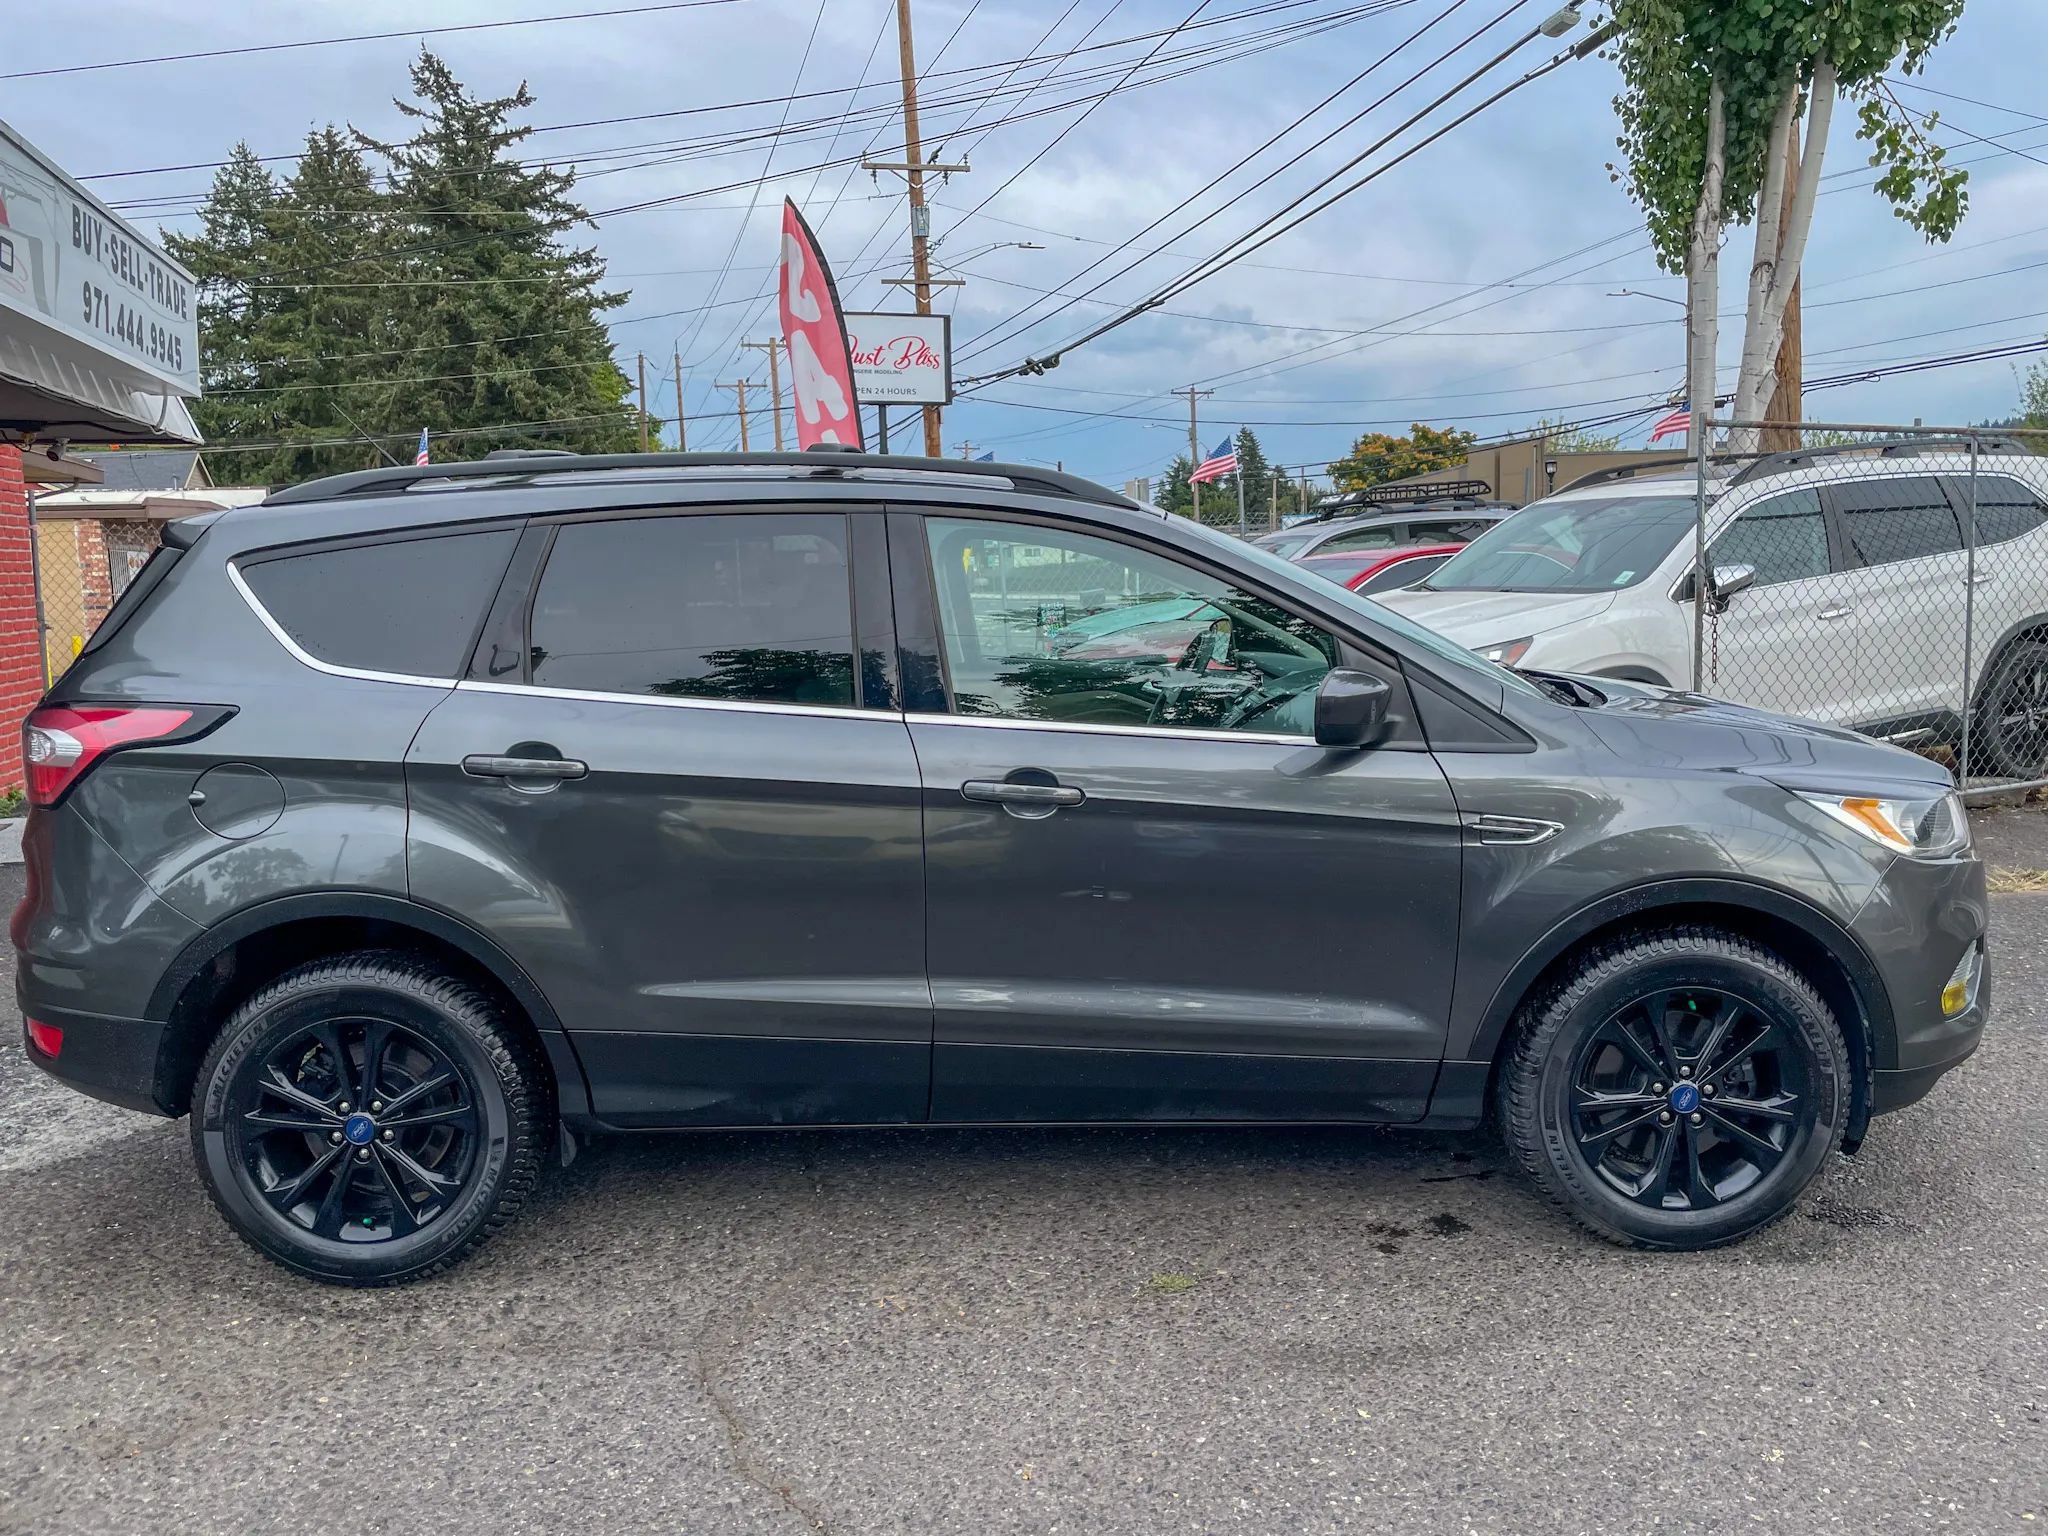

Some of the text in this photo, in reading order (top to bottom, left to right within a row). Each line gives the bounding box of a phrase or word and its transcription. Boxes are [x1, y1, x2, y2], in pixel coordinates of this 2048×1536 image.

[83, 281, 182, 371] 971.444.9945
[888, 336, 940, 369] Bliss
[856, 386, 872, 394] PEN
[887, 387, 917, 395] HOURS
[212, 1021, 263, 1098] MICHELIN
[1782, 995, 1832, 1068] MICHELIN
